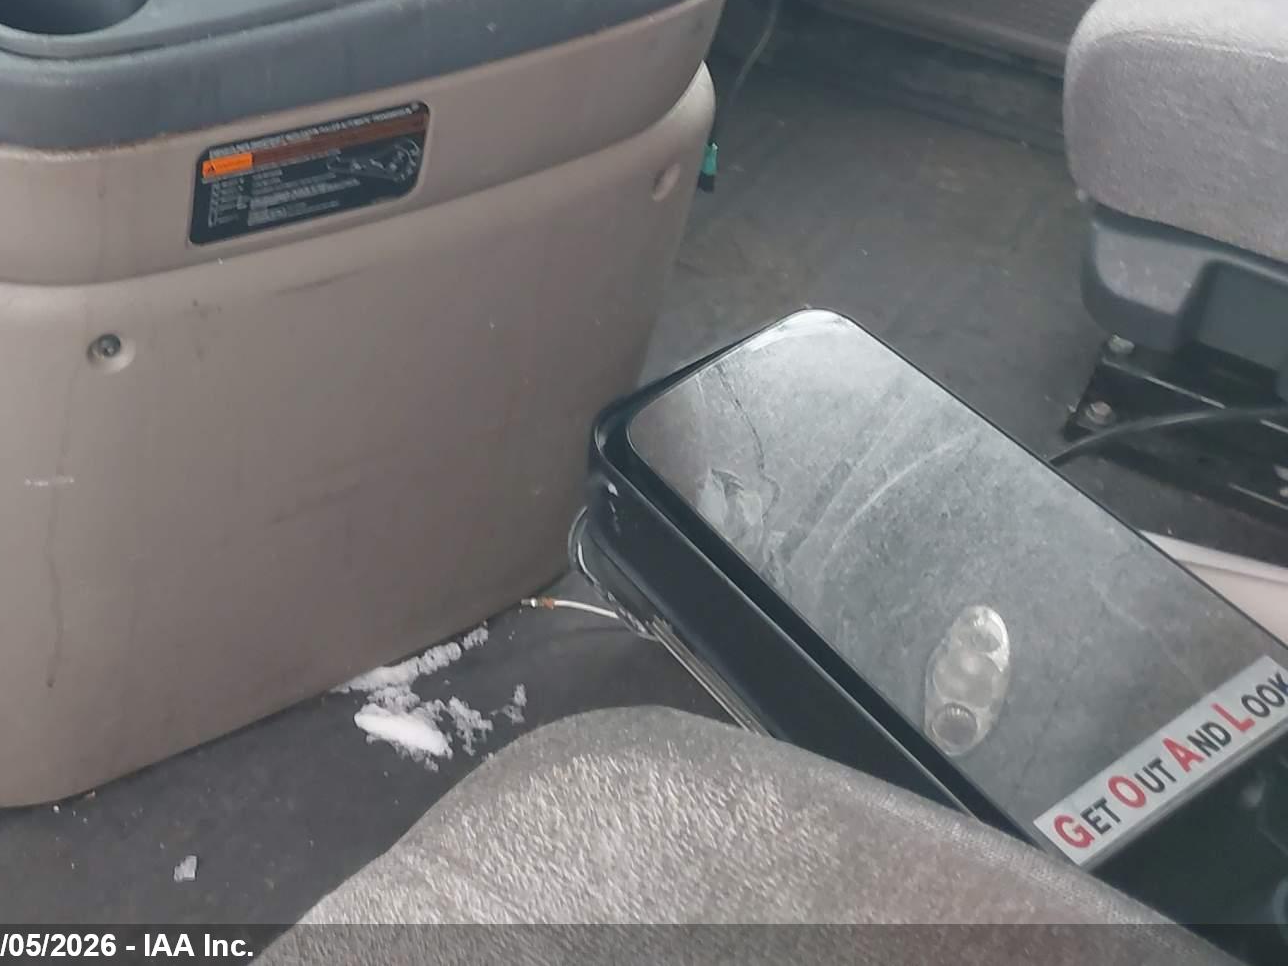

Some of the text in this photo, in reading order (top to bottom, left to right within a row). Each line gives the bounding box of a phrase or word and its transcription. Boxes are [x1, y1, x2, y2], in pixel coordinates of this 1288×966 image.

[1053, 671, 1288, 849] GET OUT AND LOOK
